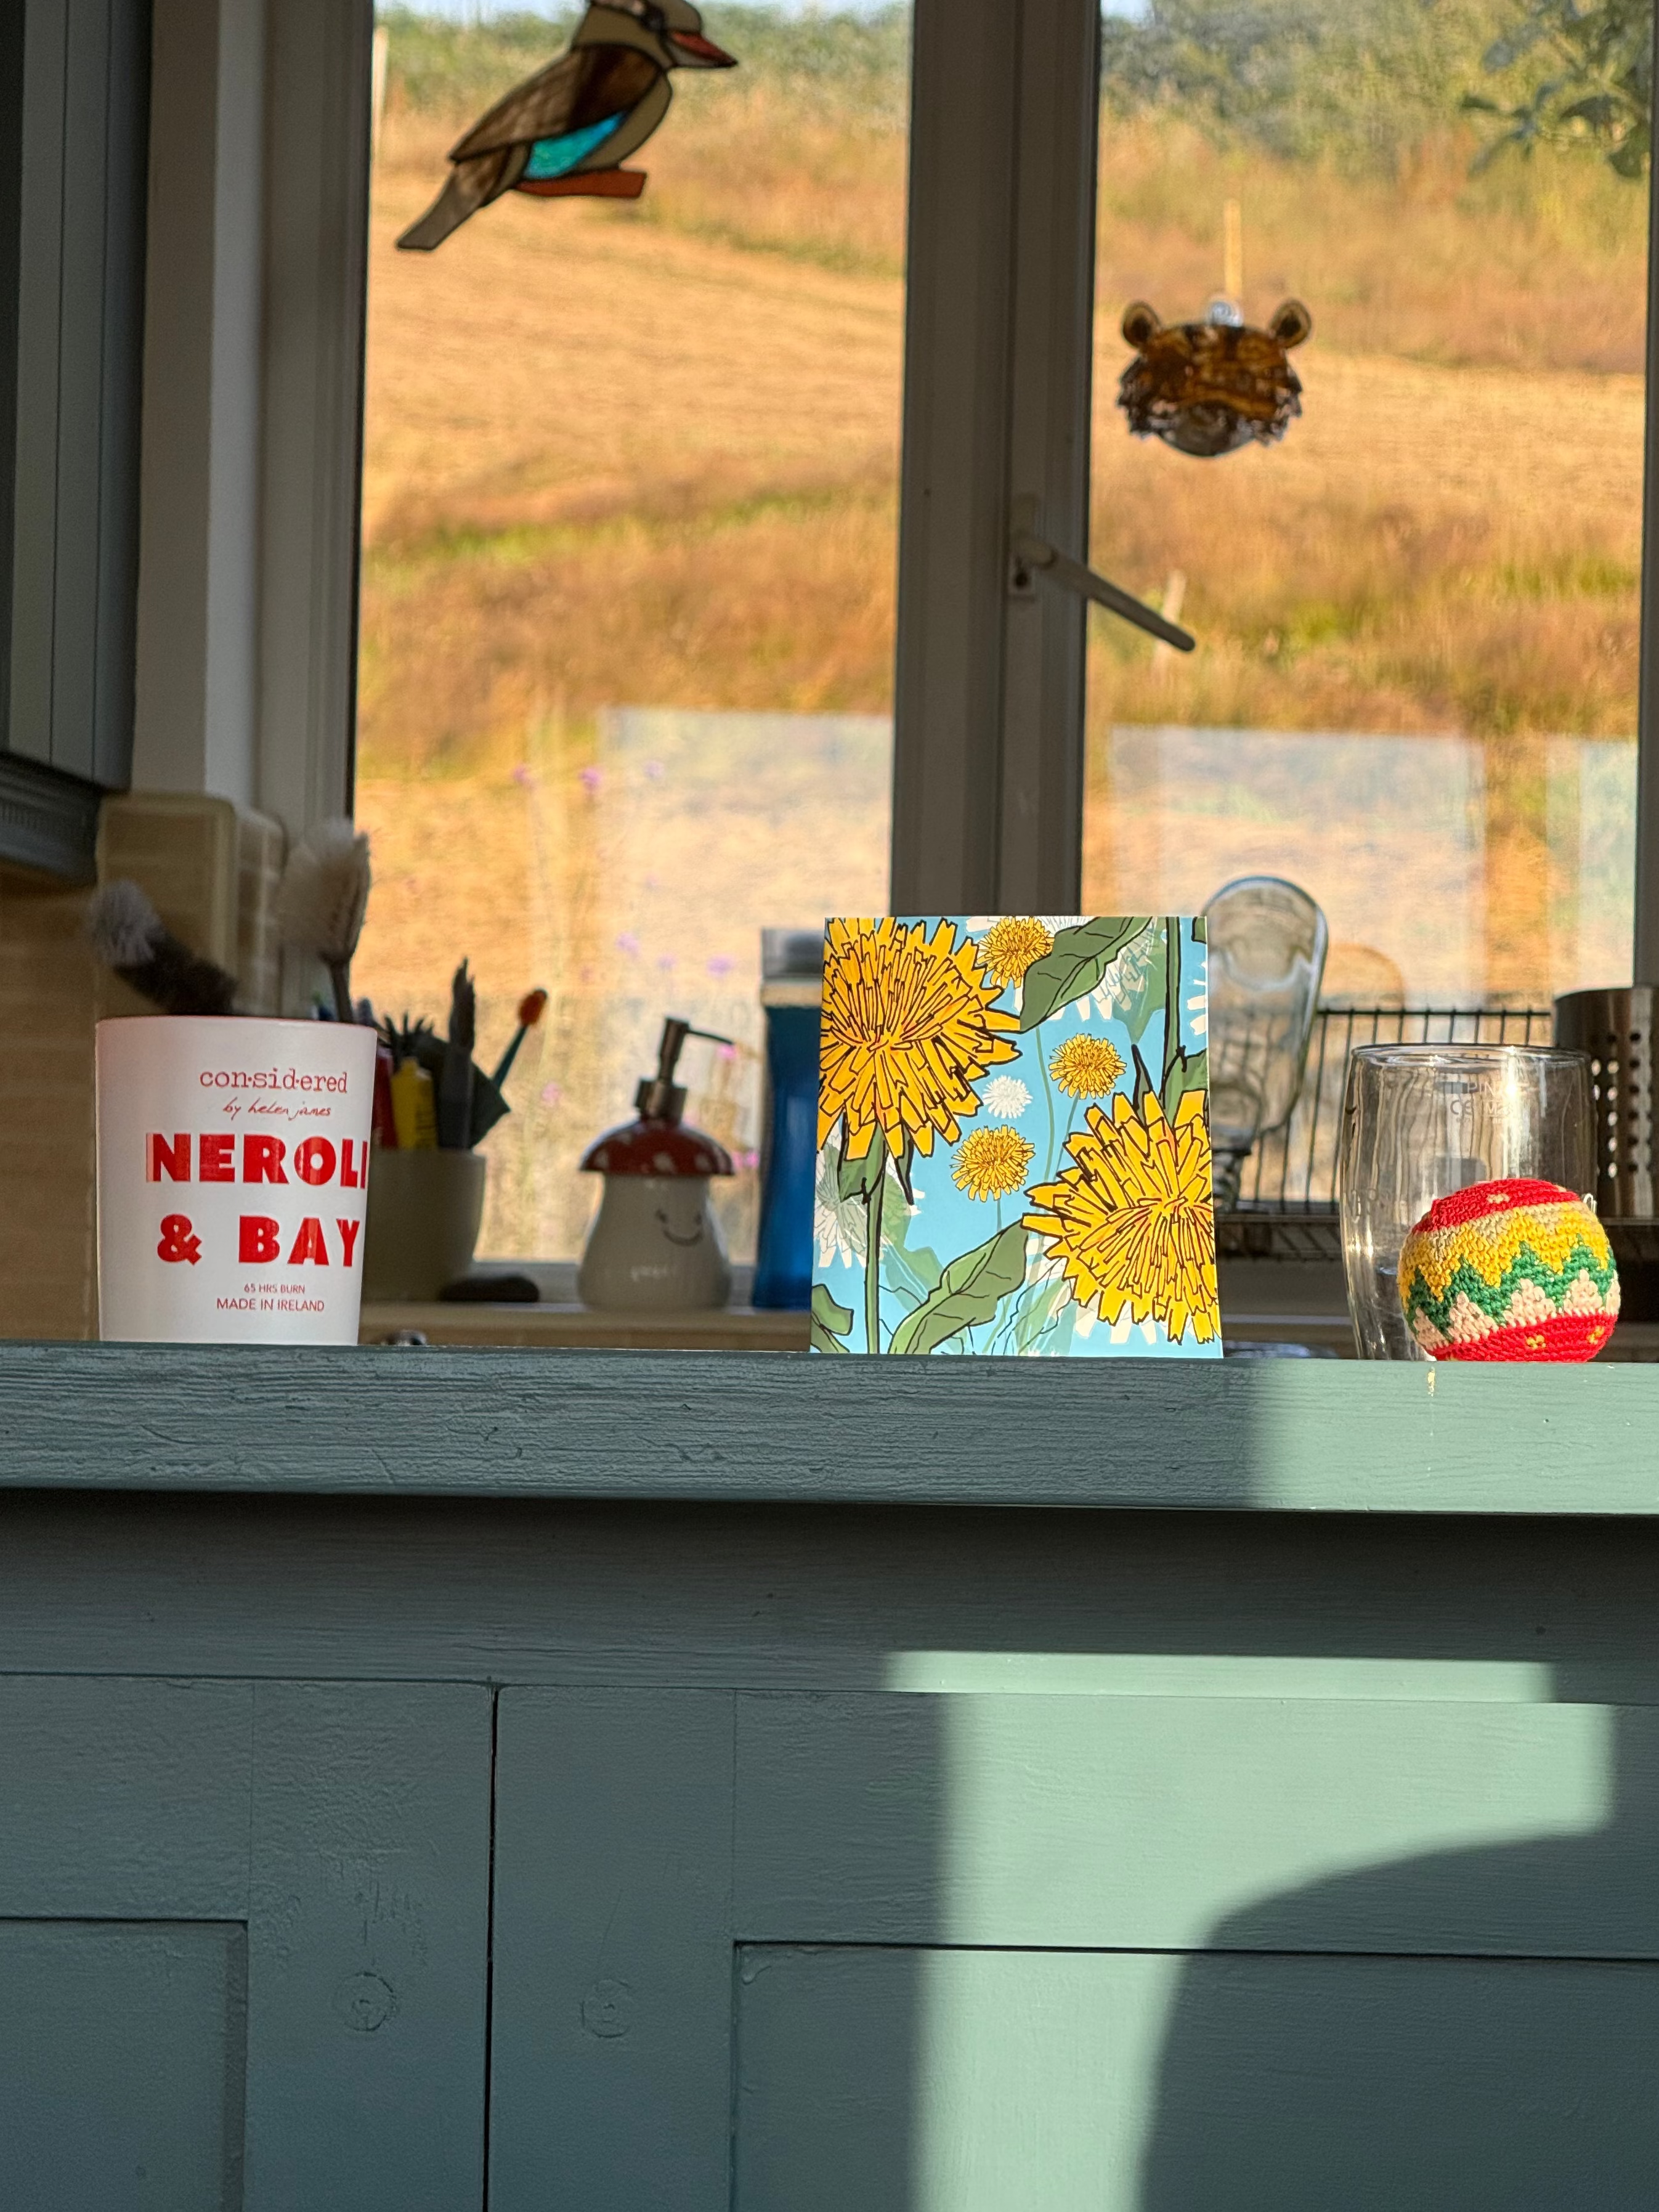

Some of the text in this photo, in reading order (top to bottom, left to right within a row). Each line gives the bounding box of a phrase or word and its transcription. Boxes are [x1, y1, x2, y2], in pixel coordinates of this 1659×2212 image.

[223, 1097, 241, 1121] by
[248, 1097, 288, 1115] helen
[146, 1133, 368, 1189] NEROLI
[157, 1214, 360, 1267] & BAY
[244, 1283, 305, 1294] 65 HRS BURN
[217, 1298, 325, 1312] MADE IN IRELAND
